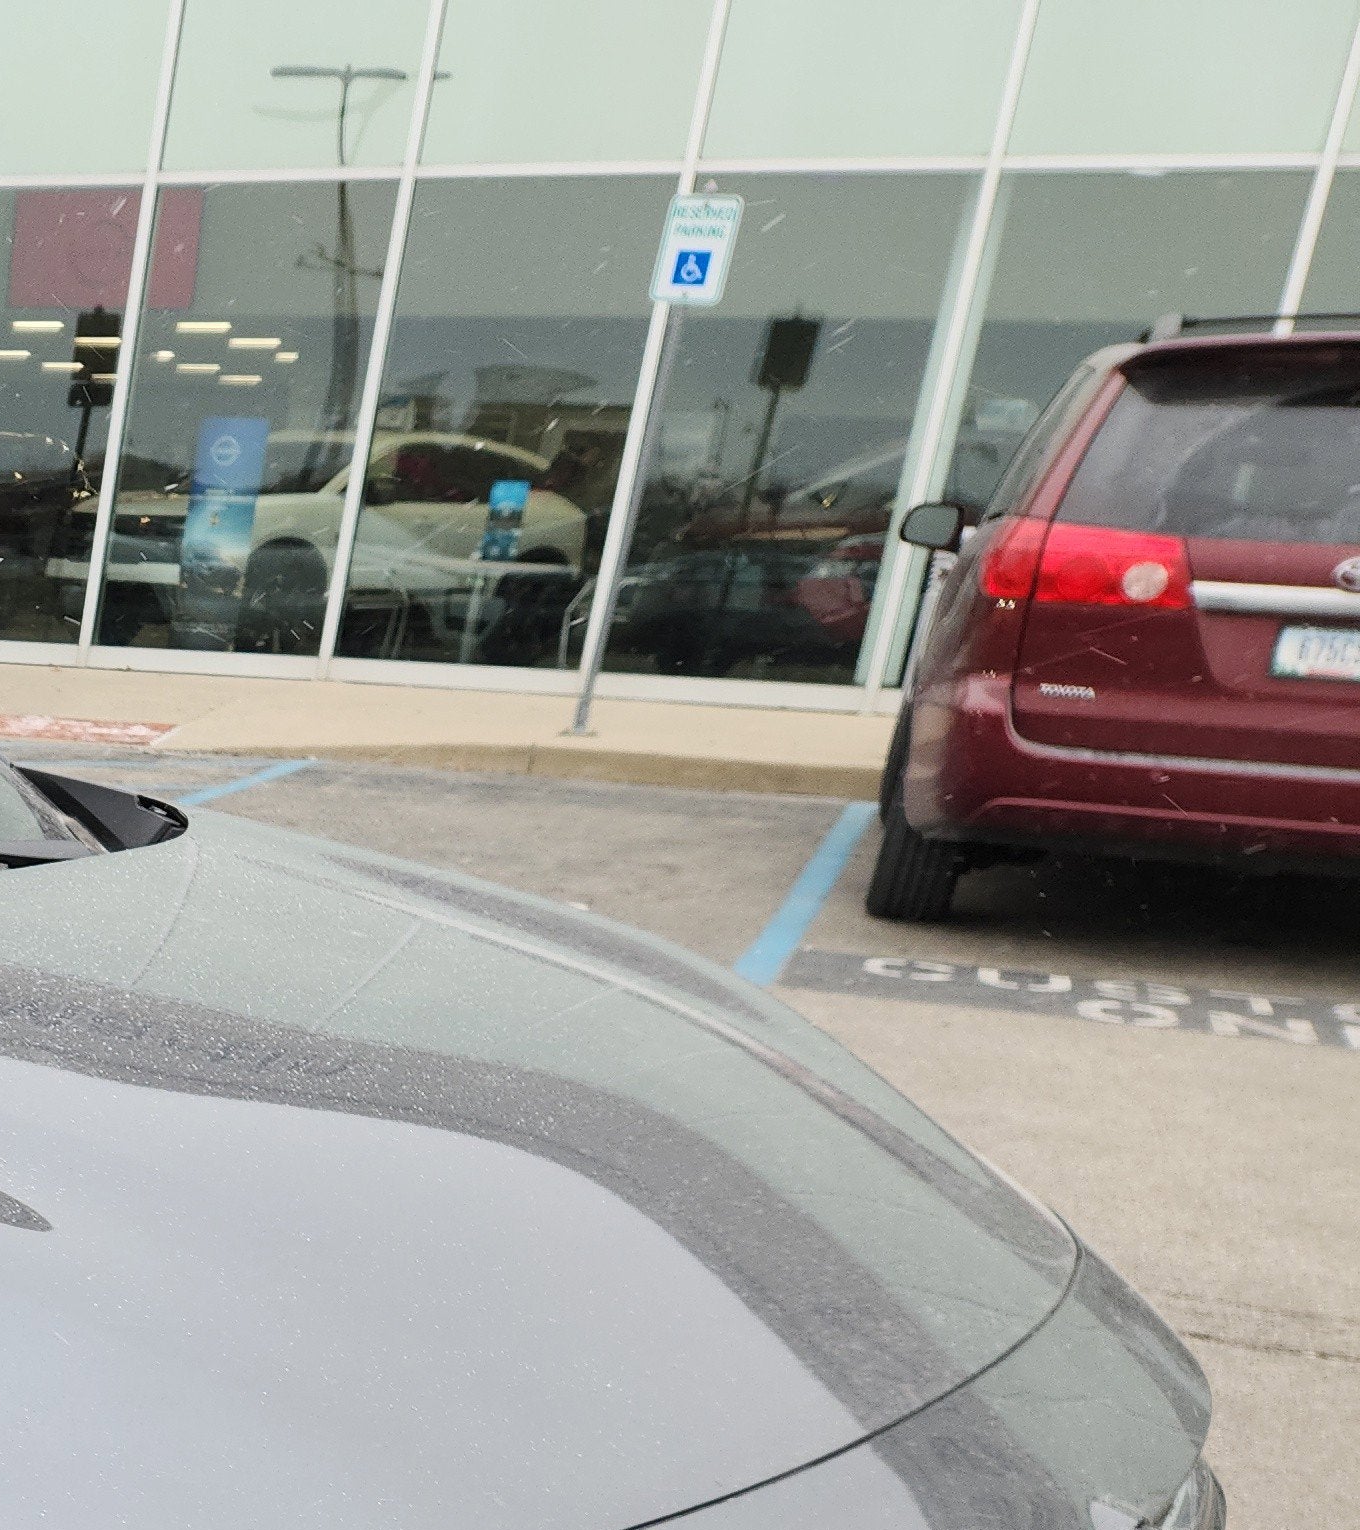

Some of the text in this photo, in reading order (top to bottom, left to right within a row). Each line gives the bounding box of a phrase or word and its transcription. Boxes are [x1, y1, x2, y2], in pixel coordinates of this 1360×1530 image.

[673, 204, 737, 221] RESERVED
[676, 224, 724, 238] PARKING
[1039, 682, 1096, 700] TOYOTA
